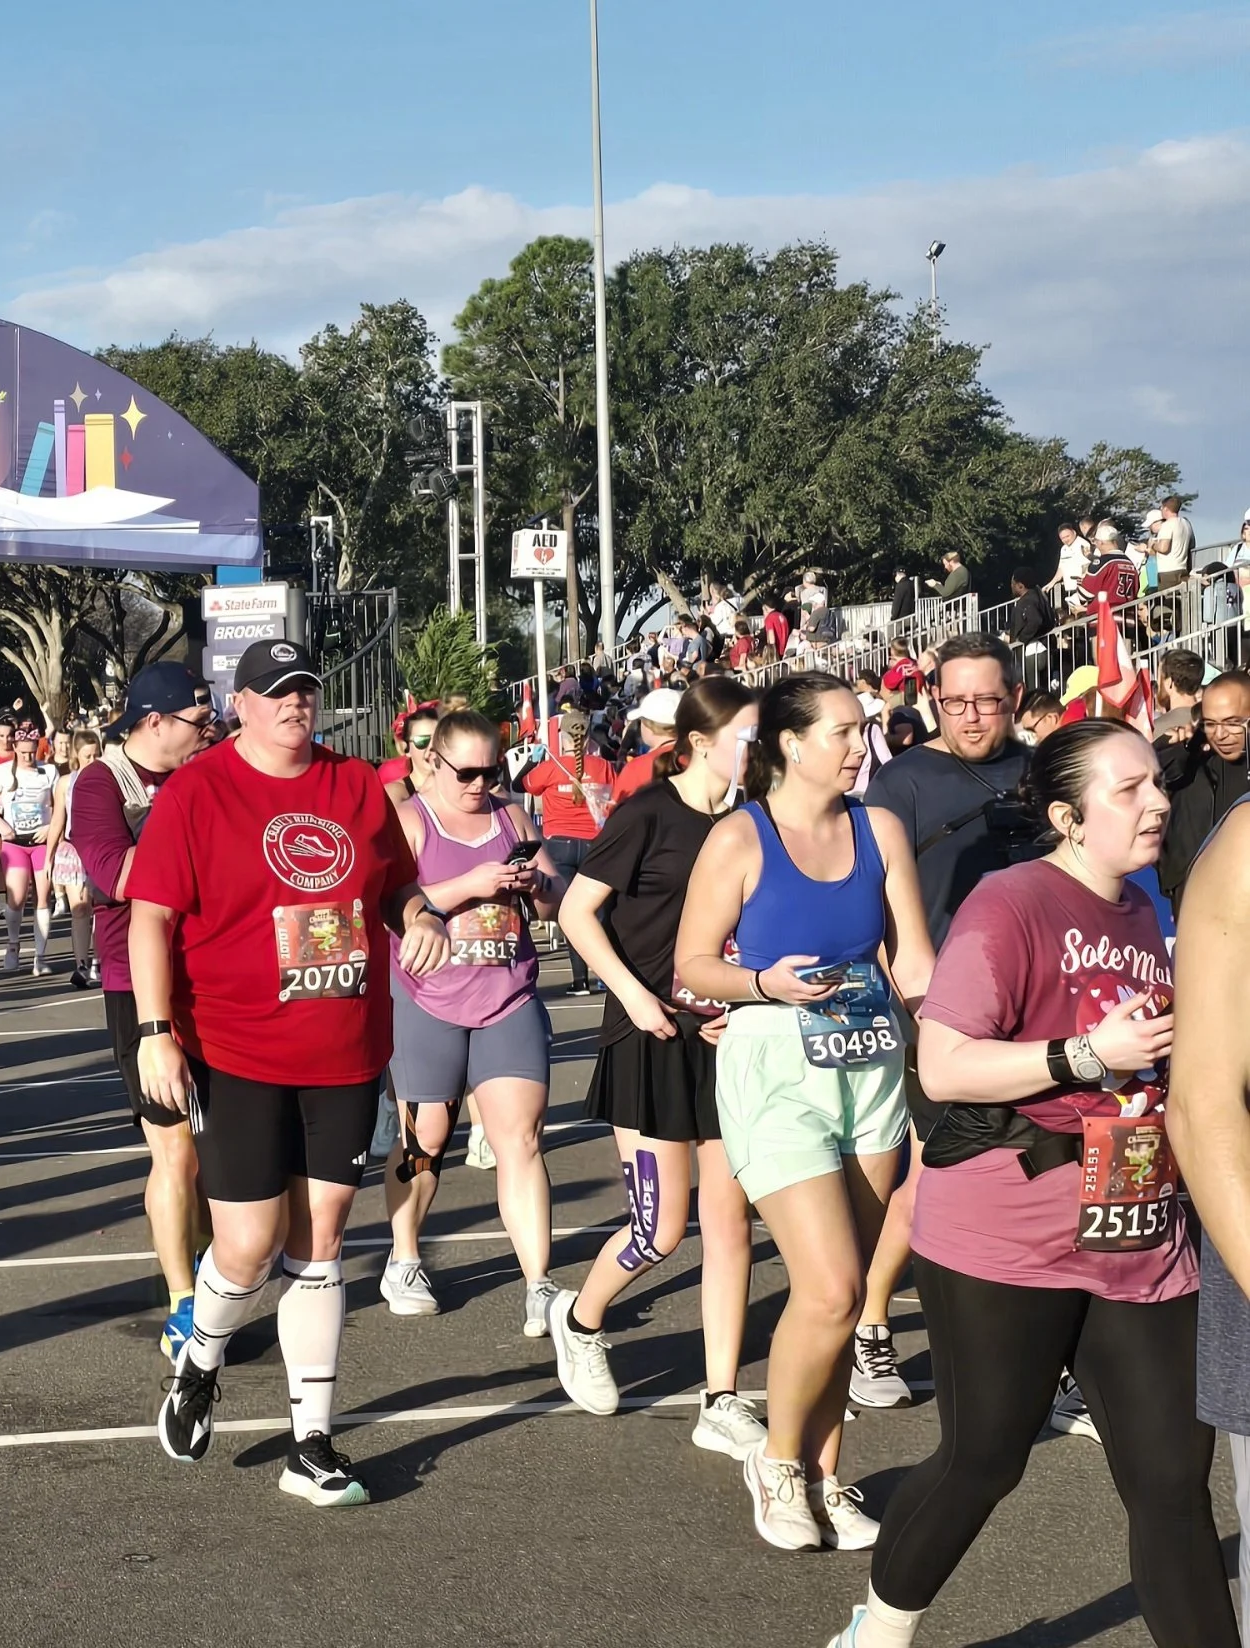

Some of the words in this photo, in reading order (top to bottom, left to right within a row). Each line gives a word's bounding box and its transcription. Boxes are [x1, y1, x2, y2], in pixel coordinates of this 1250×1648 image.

[532, 533, 558, 548] AED
[214, 624, 276, 640] BROOKS
[290, 869, 339, 889] COMPANY
[455, 940, 517, 959] 24813
[1060, 928, 1125, 974] Sole
[286, 961, 366, 992] 20707
[808, 1029, 898, 1061] 30498
[1085, 1147, 1100, 1193] 25153
[1082, 1200, 1169, 1239] 25153
